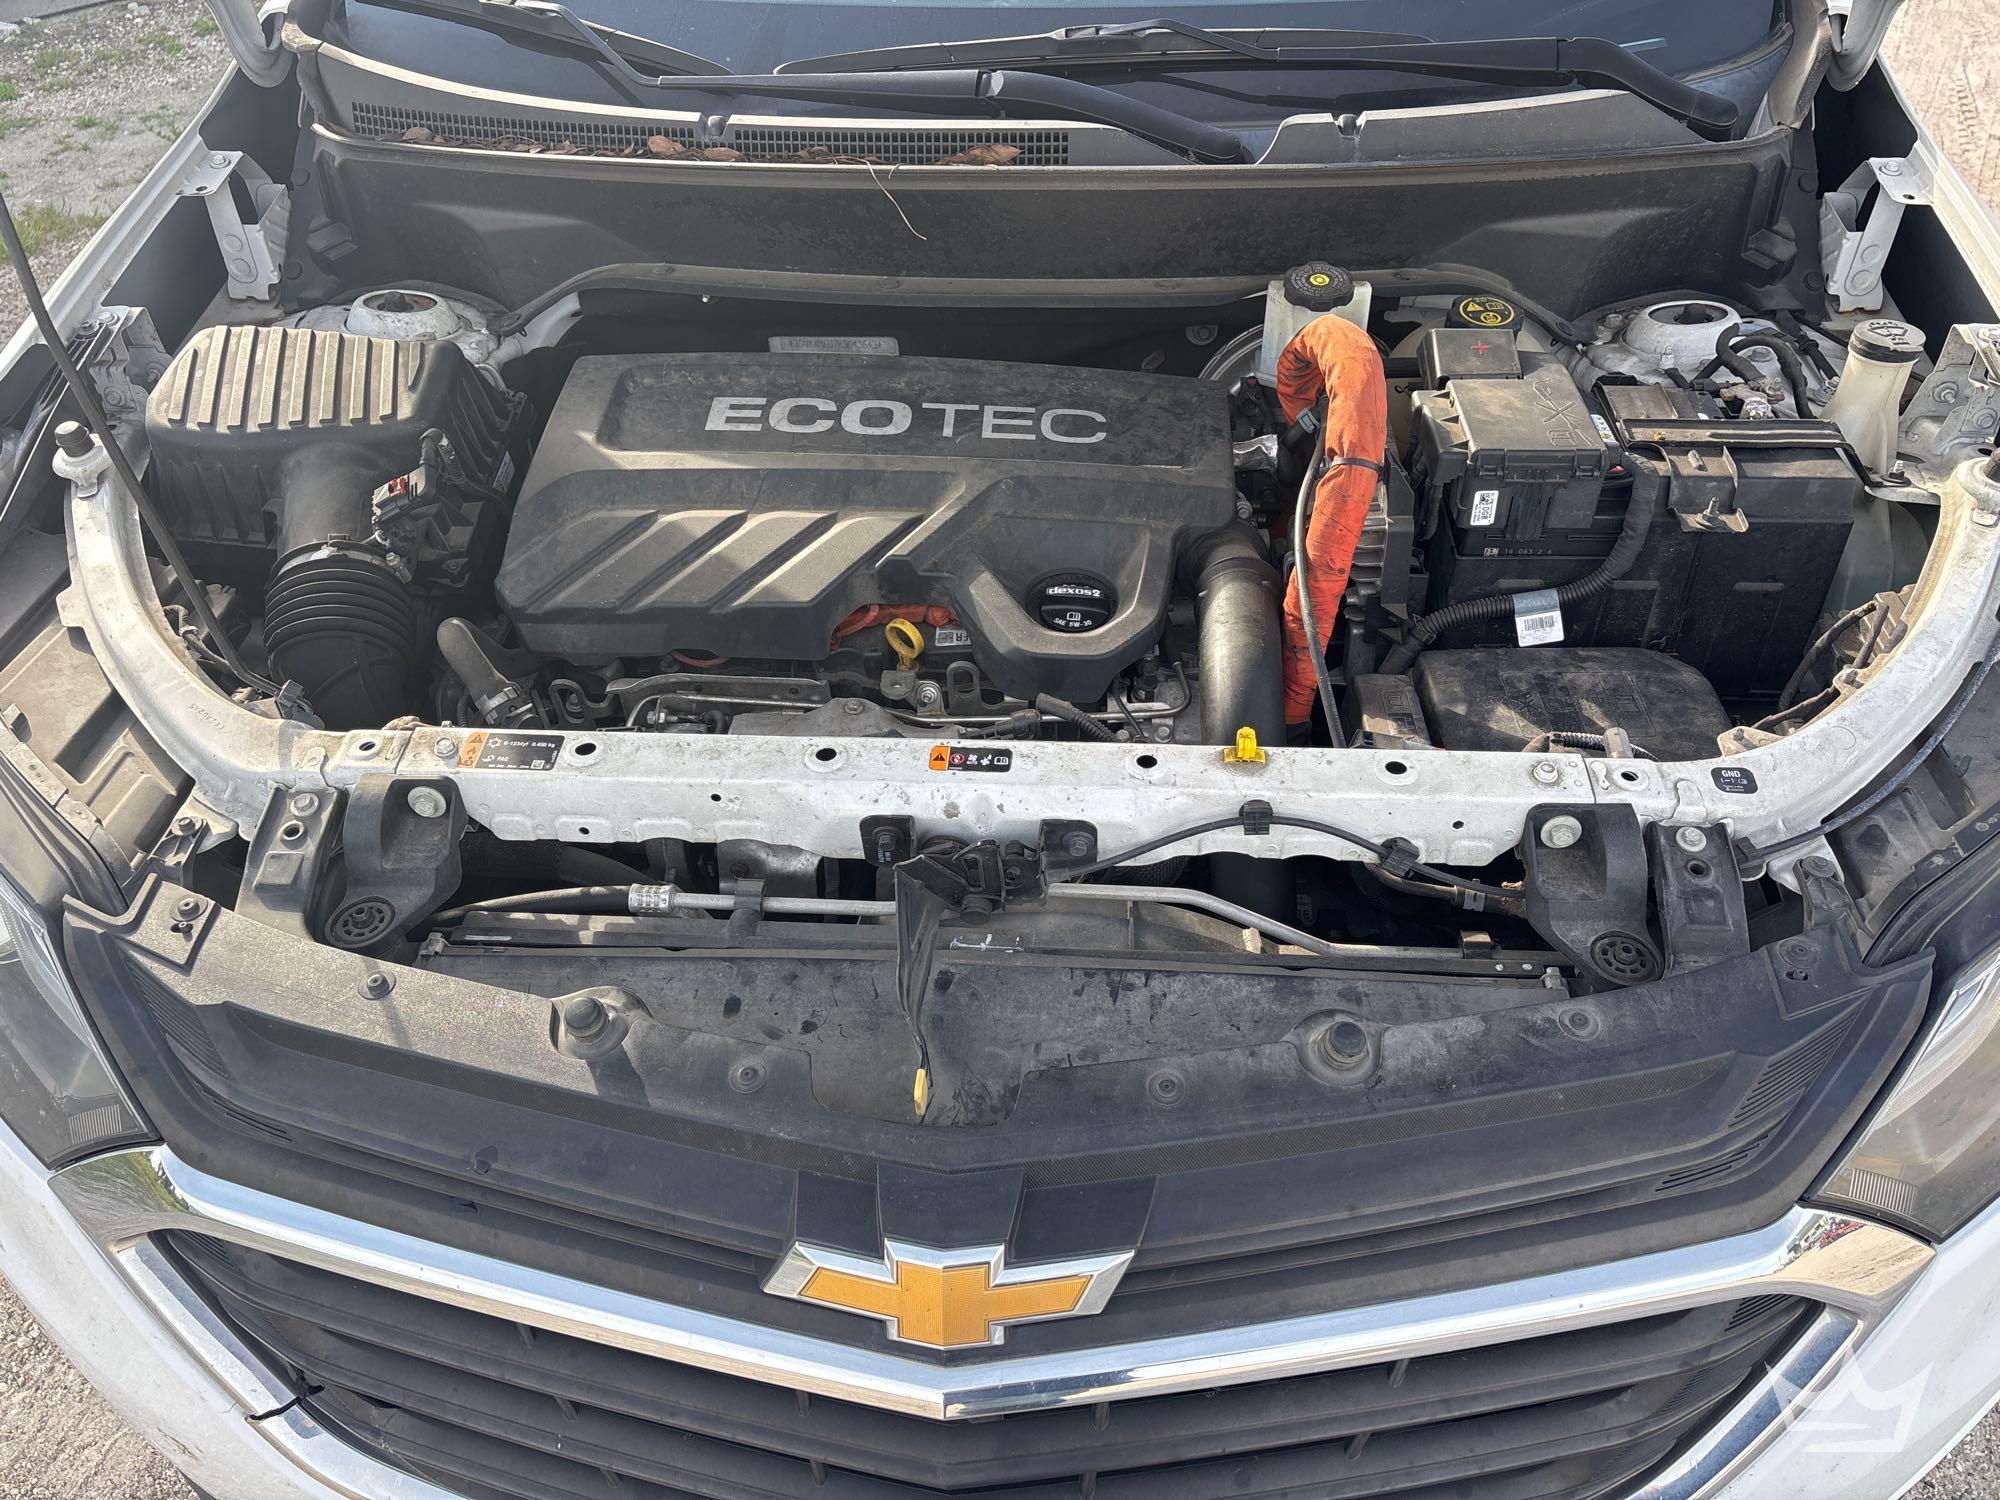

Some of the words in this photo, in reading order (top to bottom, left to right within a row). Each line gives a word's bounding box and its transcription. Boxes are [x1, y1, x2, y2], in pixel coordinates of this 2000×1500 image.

[1048, 586, 1101, 597] dexos2
[1053, 617, 1067, 626] SAE
[1068, 619, 1092, 627] 5W-30
